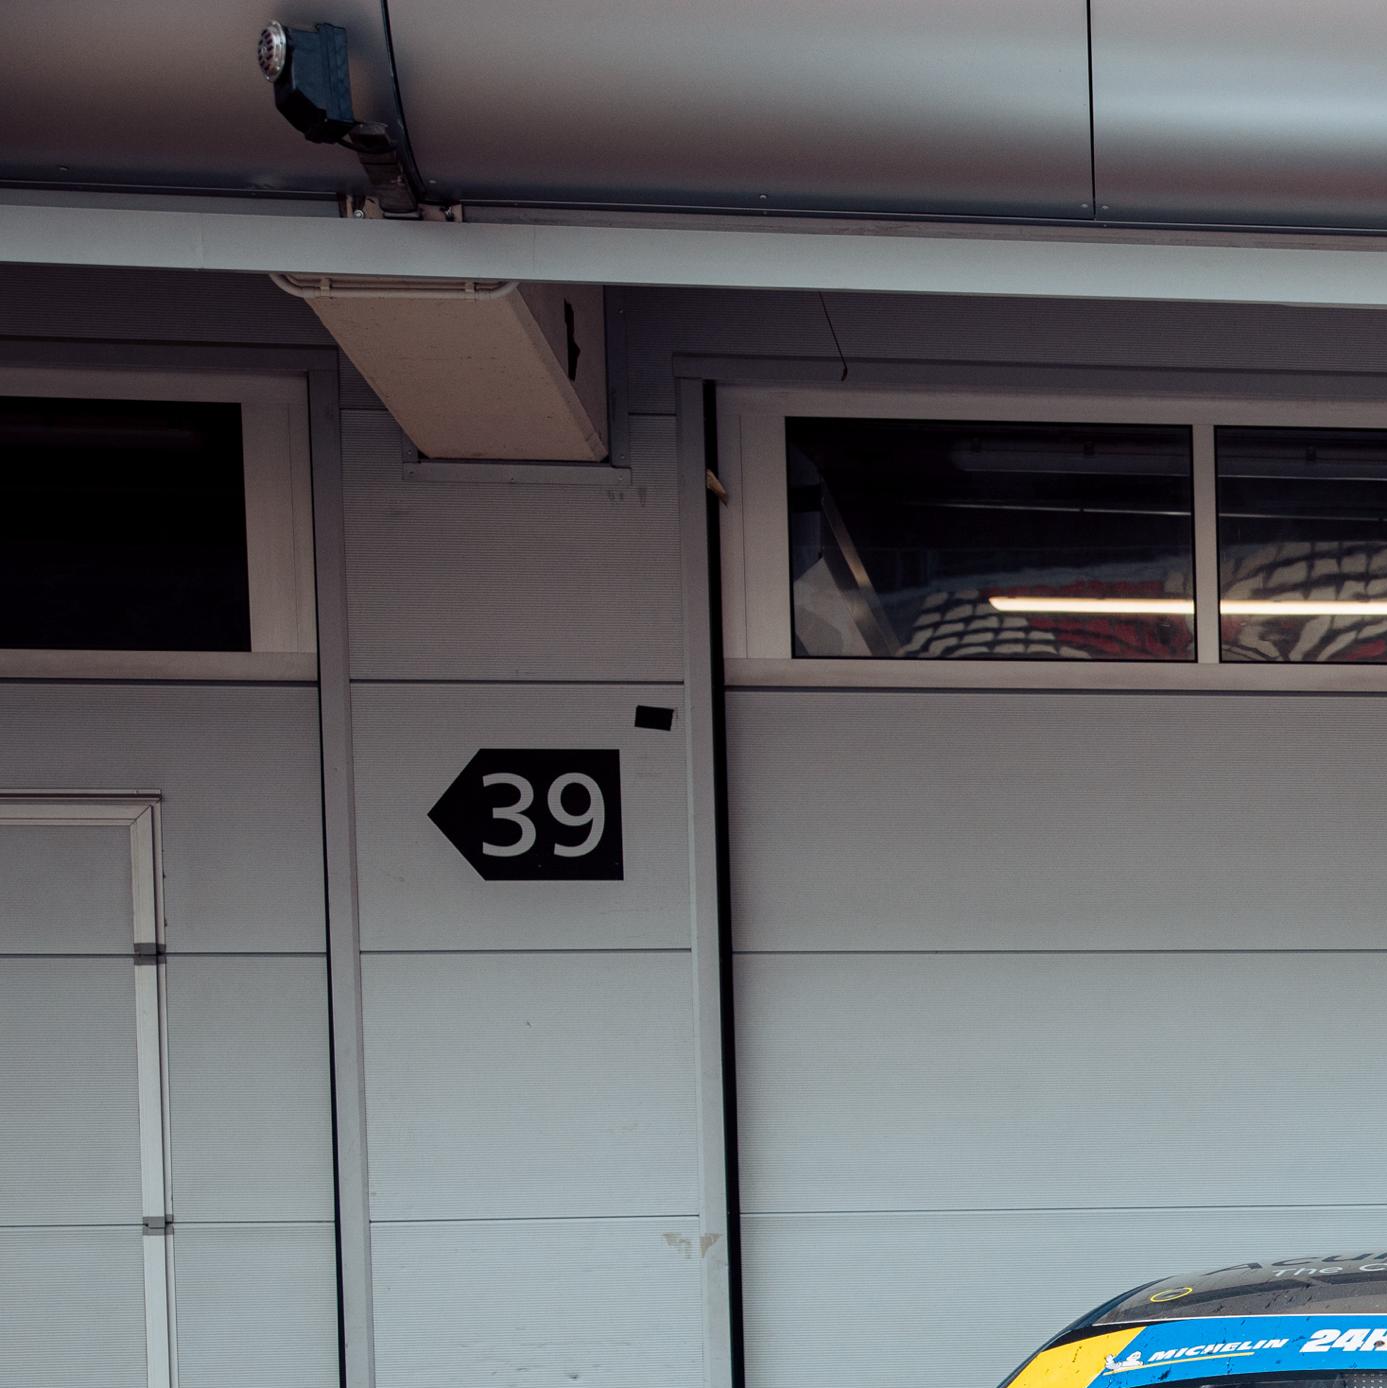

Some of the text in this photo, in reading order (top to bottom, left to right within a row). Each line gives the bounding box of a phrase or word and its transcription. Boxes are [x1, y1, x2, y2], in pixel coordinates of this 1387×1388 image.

[482, 772, 605, 857] 39
[1272, 1265, 1340, 1278] The
[1148, 1338, 1289, 1363] MICHELIN
